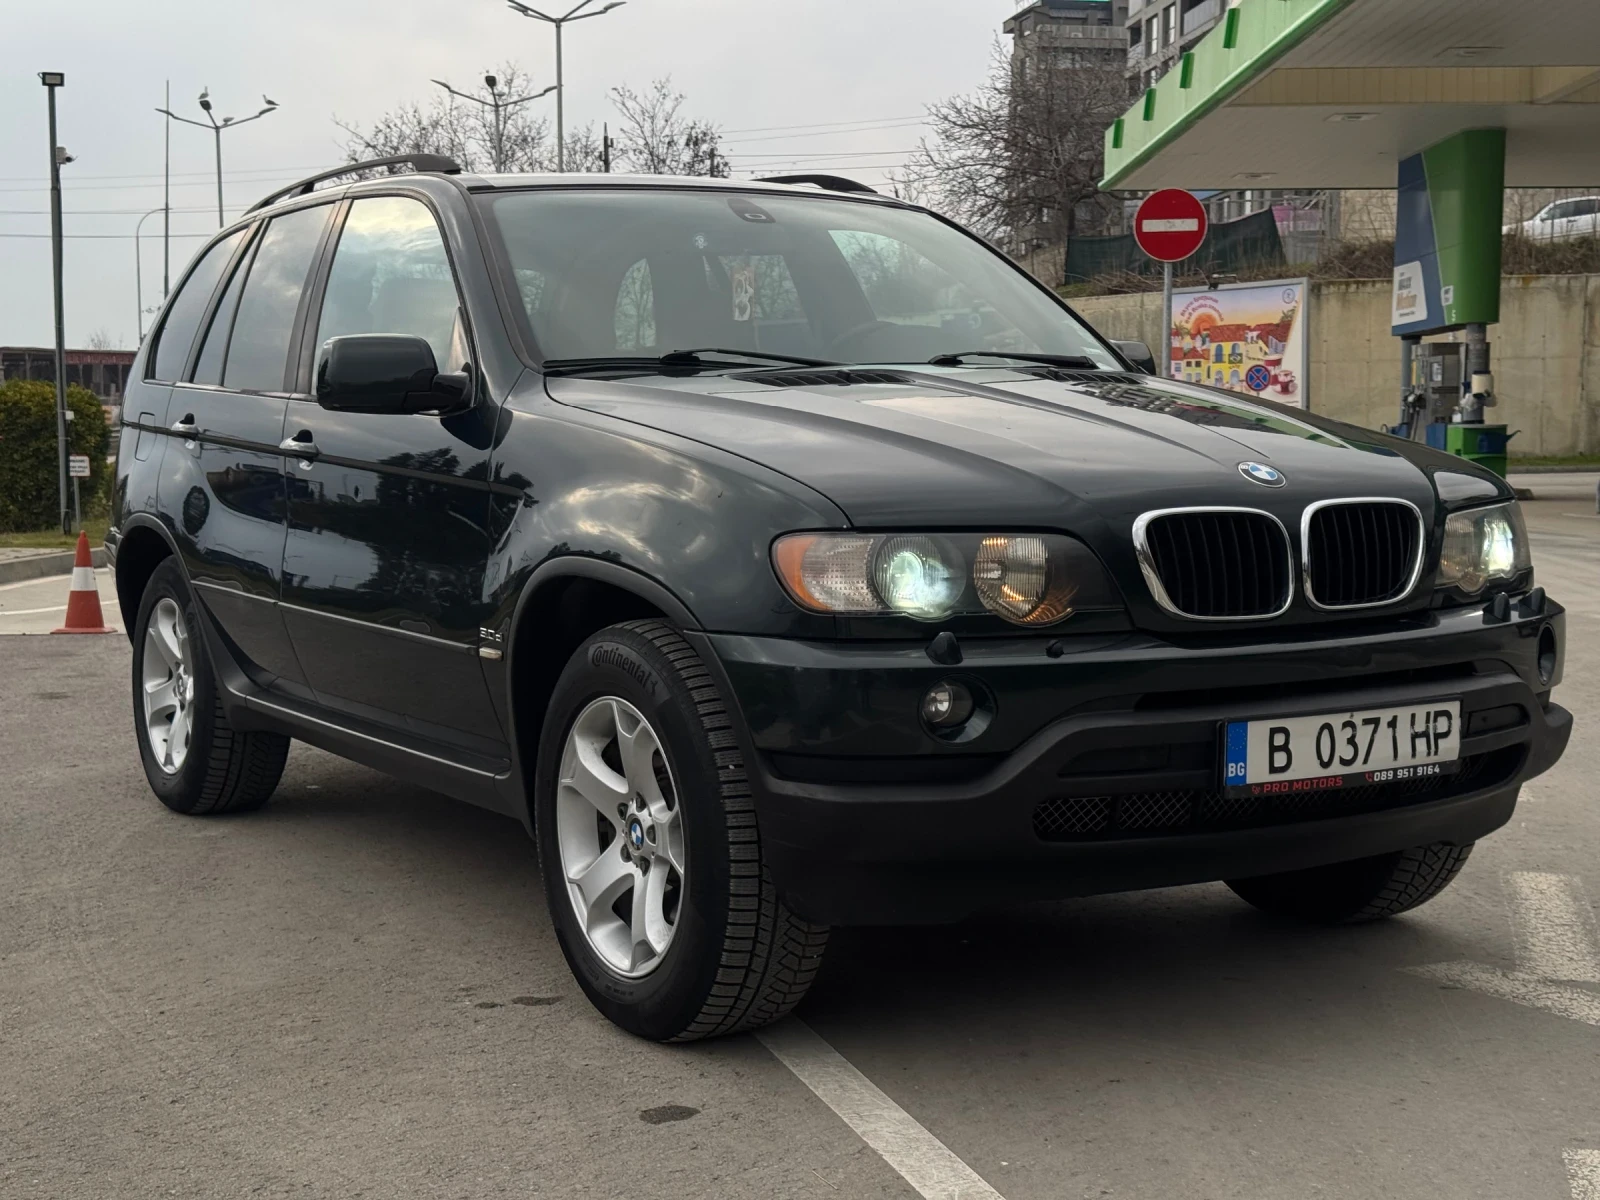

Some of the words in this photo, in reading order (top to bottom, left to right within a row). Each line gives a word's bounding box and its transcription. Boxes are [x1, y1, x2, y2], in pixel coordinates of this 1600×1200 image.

[591, 645, 653, 689] Continental
[1268, 726, 1293, 774] B
[1315, 714, 1400, 770] 0371
[1410, 709, 1453, 760] HP
[1227, 762, 1246, 777] BG
[1373, 770, 1394, 782] 089
[1396, 766, 1415, 779] 951
[1416, 763, 1440, 777] 9164
[1263, 780, 1289, 794] PRO
[1292, 775, 1343, 791] MOTORS
